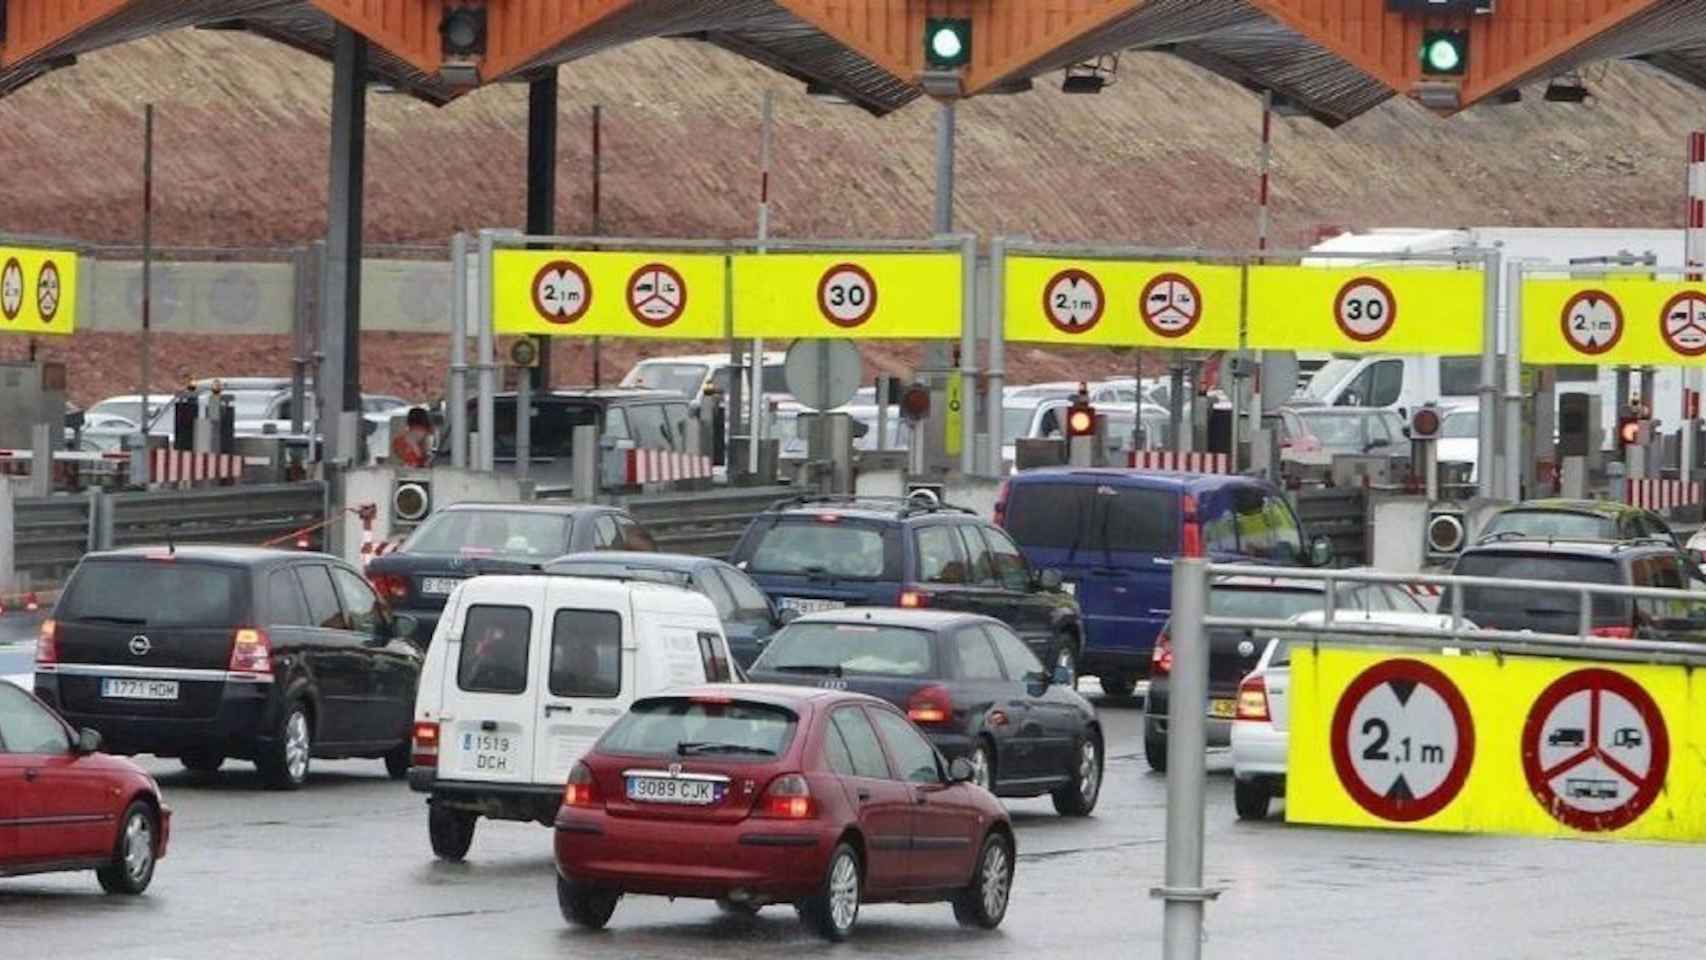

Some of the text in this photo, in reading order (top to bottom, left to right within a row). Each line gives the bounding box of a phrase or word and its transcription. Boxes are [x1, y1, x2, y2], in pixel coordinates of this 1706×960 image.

[830, 285, 865, 306] 30
[1347, 299, 1383, 320] 30
[114, 680, 145, 695] 1771
[477, 736, 509, 752] 1519
[477, 754, 506, 769] DCH
[638, 781, 710, 799] 9089 CJK
